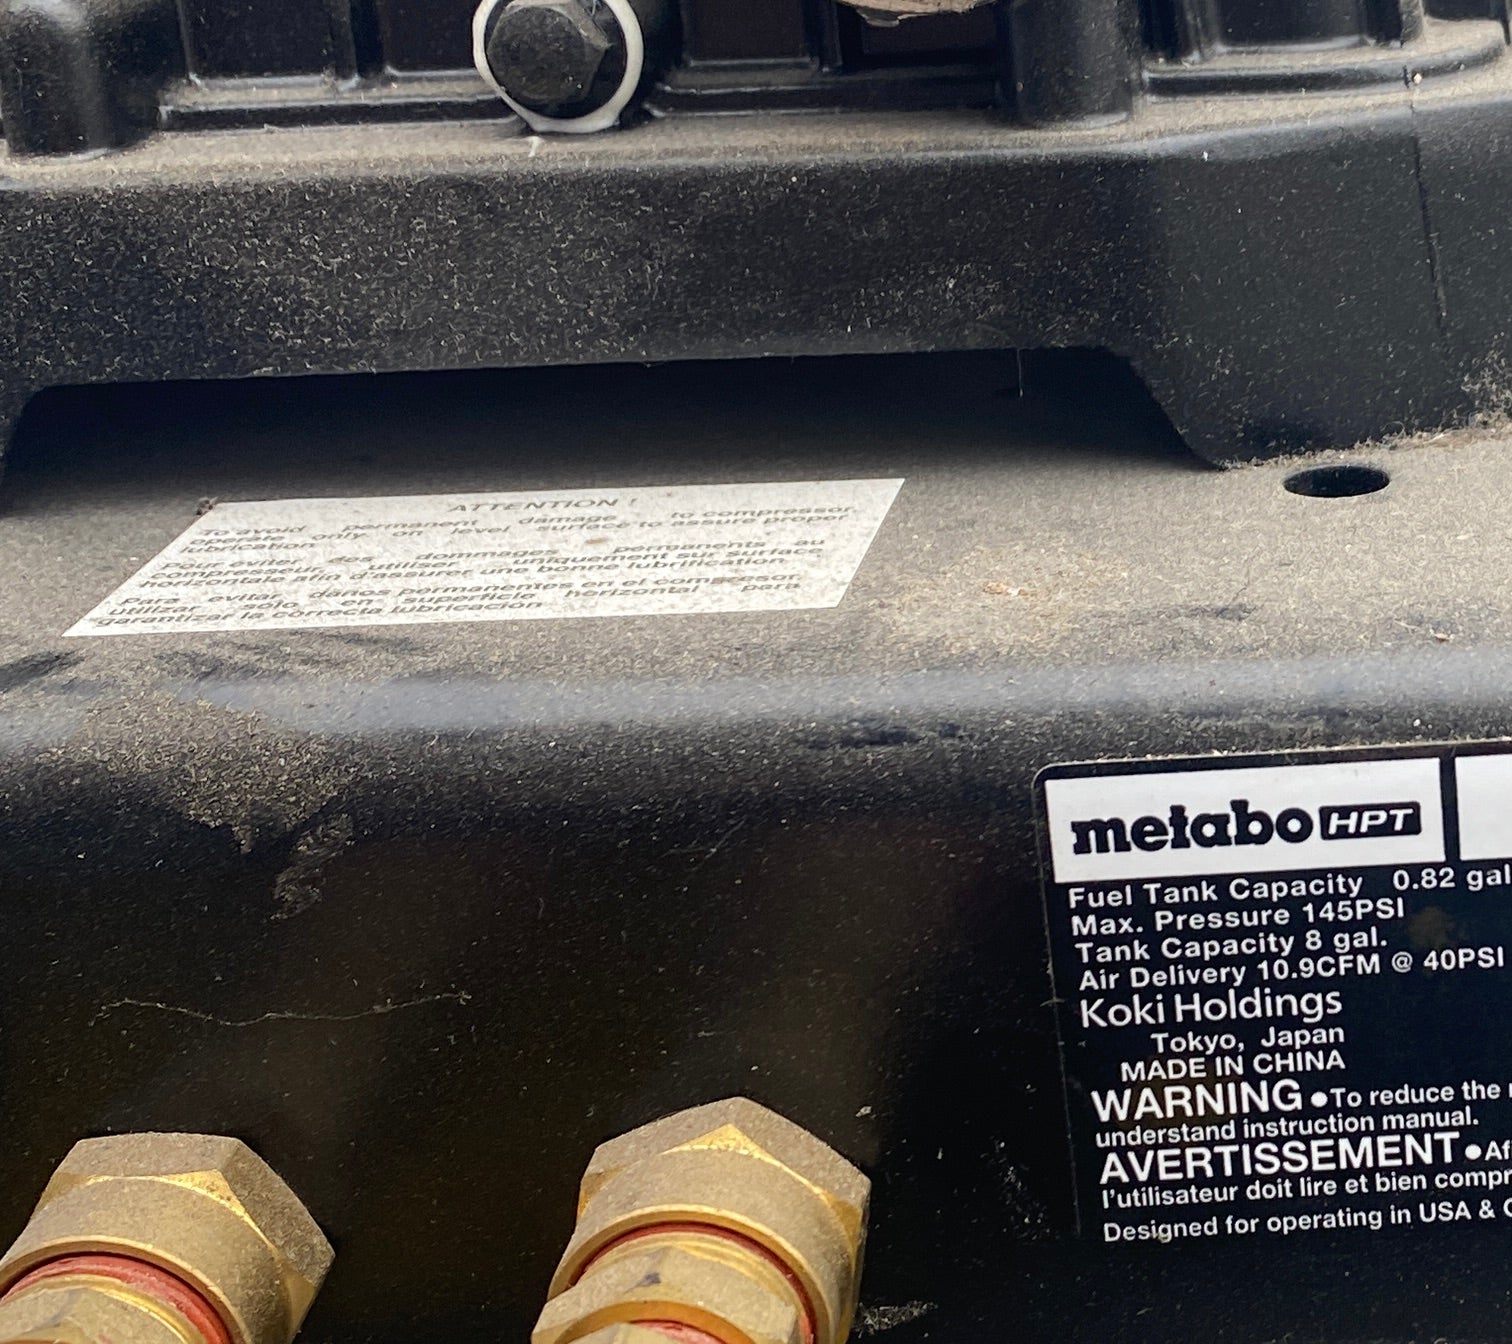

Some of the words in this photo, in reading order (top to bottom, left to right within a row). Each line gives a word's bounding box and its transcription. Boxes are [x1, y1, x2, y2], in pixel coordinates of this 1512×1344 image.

[450, 499, 619, 511] ATTENTION
[1071, 799, 1314, 855] metabo
[1326, 806, 1415, 837] HPT
[1069, 885, 1132, 908] Fuel
[1142, 880, 1218, 904] Tank
[1229, 873, 1363, 902] Capacity
[1393, 867, 1455, 890] 0.82
[1466, 864, 1511, 891] gal
[1072, 914, 1143, 936] Max.
[1155, 909, 1290, 931] Pressure
[1302, 897, 1404, 923] 145PSI
[1074, 939, 1150, 963] Tank
[1161, 932, 1294, 961] Capacity
[1306, 929, 1322, 950] 8
[1333, 926, 1387, 953] gal.
[1079, 969, 1119, 991] Air
[1130, 964, 1246, 988] Delivery
[1257, 953, 1380, 980] 10.9CFM
[1391, 951, 1413, 973] @
[1424, 946, 1504, 970] 40PSI
[1080, 994, 1165, 1028] Koki
[1174, 987, 1342, 1023] Holdings
[1150, 1031, 1244, 1055] Tokyo,
[1261, 1026, 1344, 1050] Japan
[1121, 1057, 1207, 1082] MADE
[1215, 1055, 1244, 1076] IN
[1253, 1049, 1345, 1074] CHINA
[1091, 1079, 1302, 1123] WARNING
[1370, 1083, 1454, 1105] reduce
[1461, 1080, 1501, 1100] the
[1096, 1119, 1235, 1147] understand
[1243, 1113, 1374, 1138] instruction
[1382, 1105, 1479, 1130] manual.
[1099, 1132, 1461, 1186] AVERTISSEMENT
[1102, 1185, 1238, 1209] l'utilisateur
[1246, 1178, 1293, 1200] doit
[1300, 1176, 1337, 1197] lire
[1345, 1174, 1369, 1194] et
[1375, 1171, 1427, 1192] bien
[1104, 1216, 1218, 1243] Designed
[1225, 1215, 1259, 1234] for
[1267, 1207, 1382, 1235] operating
[1390, 1205, 1411, 1224] in
[1419, 1201, 1472, 1222] USA
[1479, 1199, 1495, 1219] &
